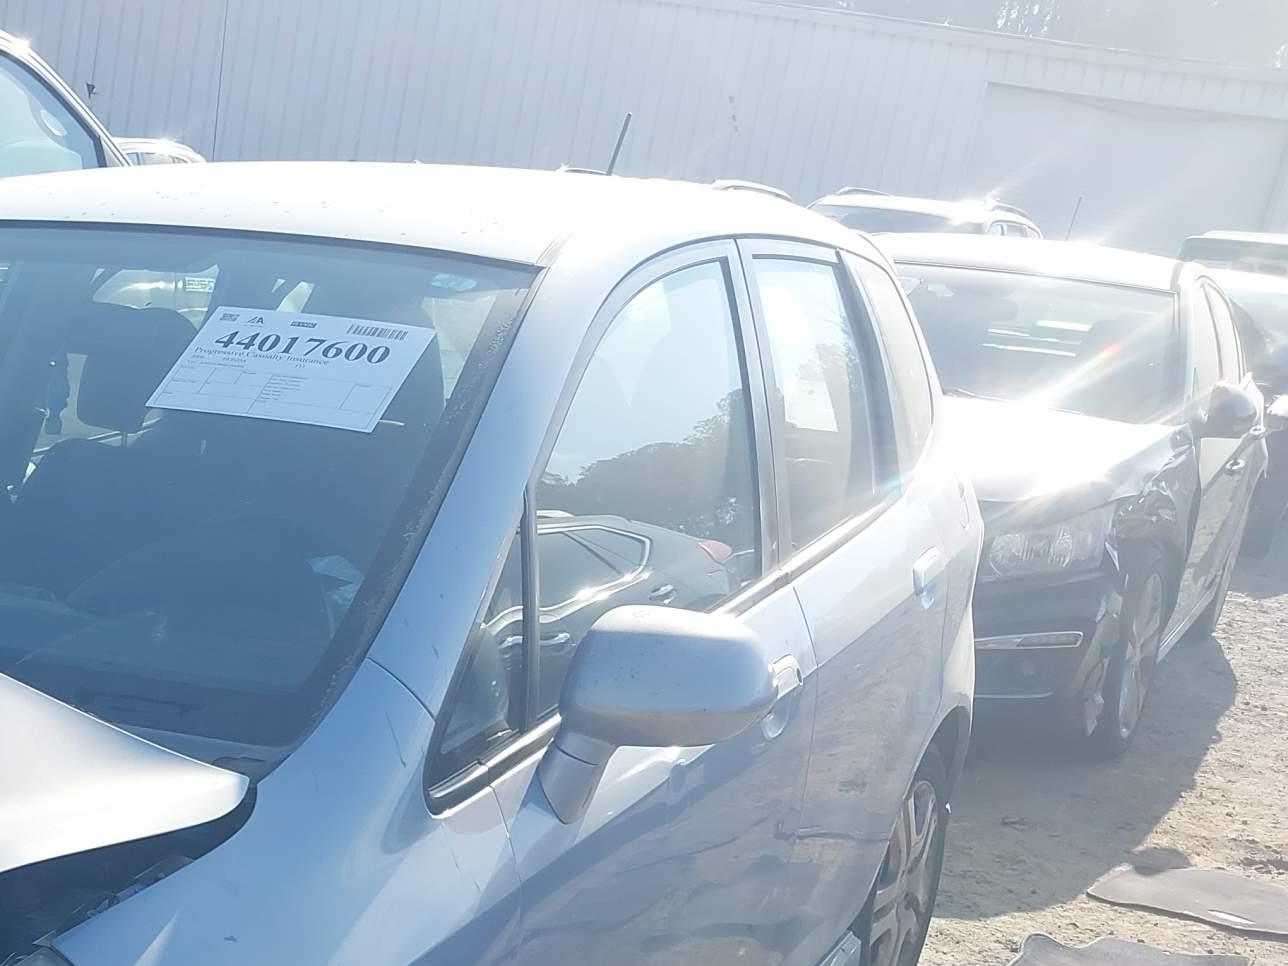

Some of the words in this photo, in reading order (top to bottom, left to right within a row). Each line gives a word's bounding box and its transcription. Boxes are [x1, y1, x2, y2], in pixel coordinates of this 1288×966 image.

[194, 347, 245, 358] Progressive
[246, 351, 284, 362] Casualty
[287, 355, 330, 365] Insurance
[215, 330, 391, 365] 44017600
